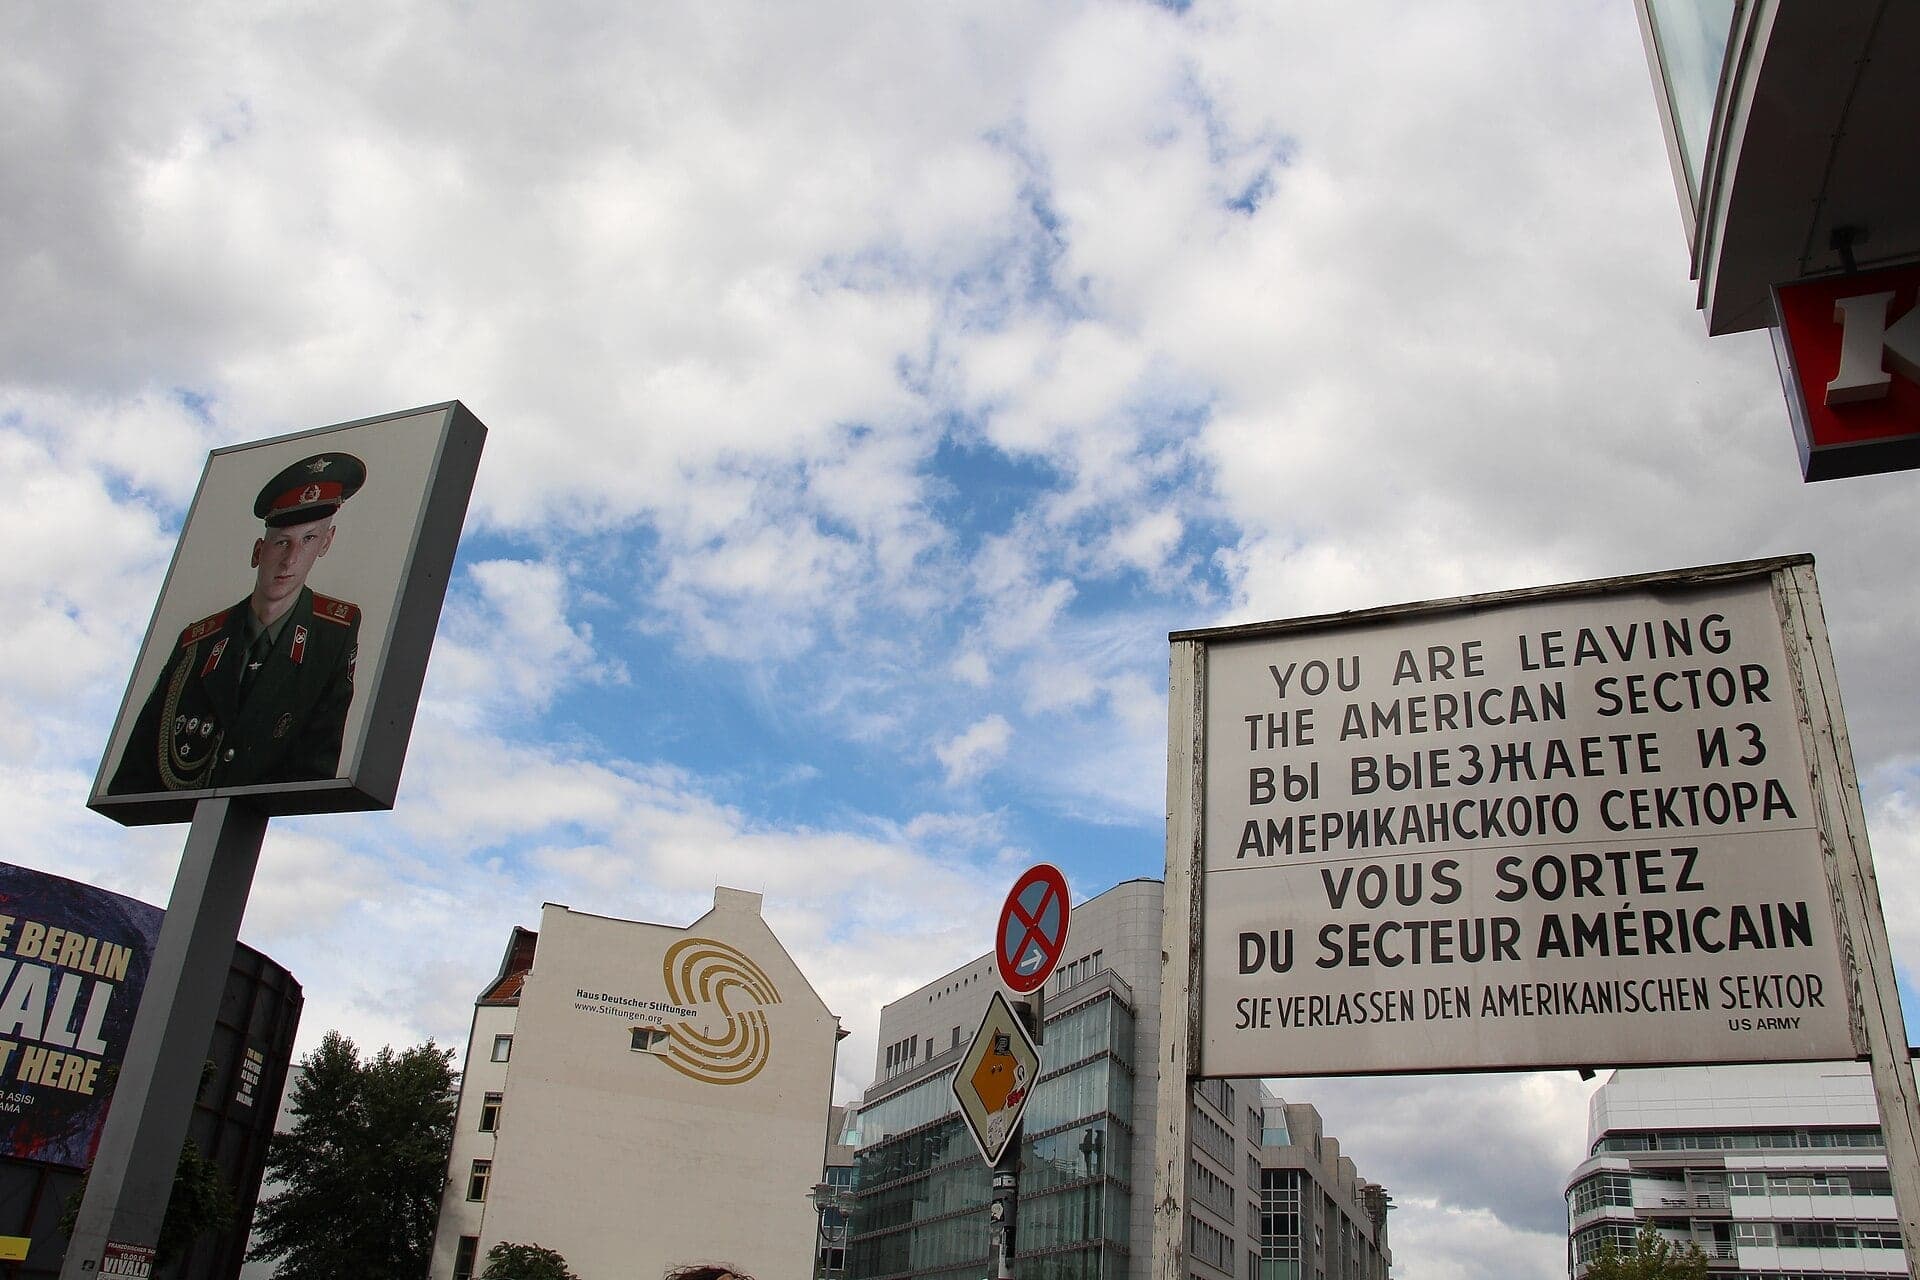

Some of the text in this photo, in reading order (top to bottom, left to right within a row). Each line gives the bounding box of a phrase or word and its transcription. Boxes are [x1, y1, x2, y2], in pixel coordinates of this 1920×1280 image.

[1268, 613, 1733, 699] YOU ARE LEAVING
[1244, 663, 1772, 751] THE AMERICAN SECTOR
[1249, 722, 1767, 806] ВЫ ВЫЕЗЖАЕТЕ ИЗ
[1236, 778, 1798, 860] АМЕРИКАНСКОГО СЕКТОРА
[1320, 846, 1705, 910] VOUS SORTEZ
[15, 920, 133, 982] BERLIN
[1238, 901, 1814, 975] DU SECTEUR AMÉRICAIN
[574, 1002, 664, 1025] www.Stiftungen.org
[576, 989, 698, 1017] Haus Deutscher Stiftungen
[1235, 973, 1825, 1030] SIE VERLASSEN DEN AMERIKANISCHEN SEKTOR
[1728, 1016, 1801, 1032] US ARMY
[6, 1091, 35, 1105] ASISI
[16, 1045, 102, 1095] HERE
